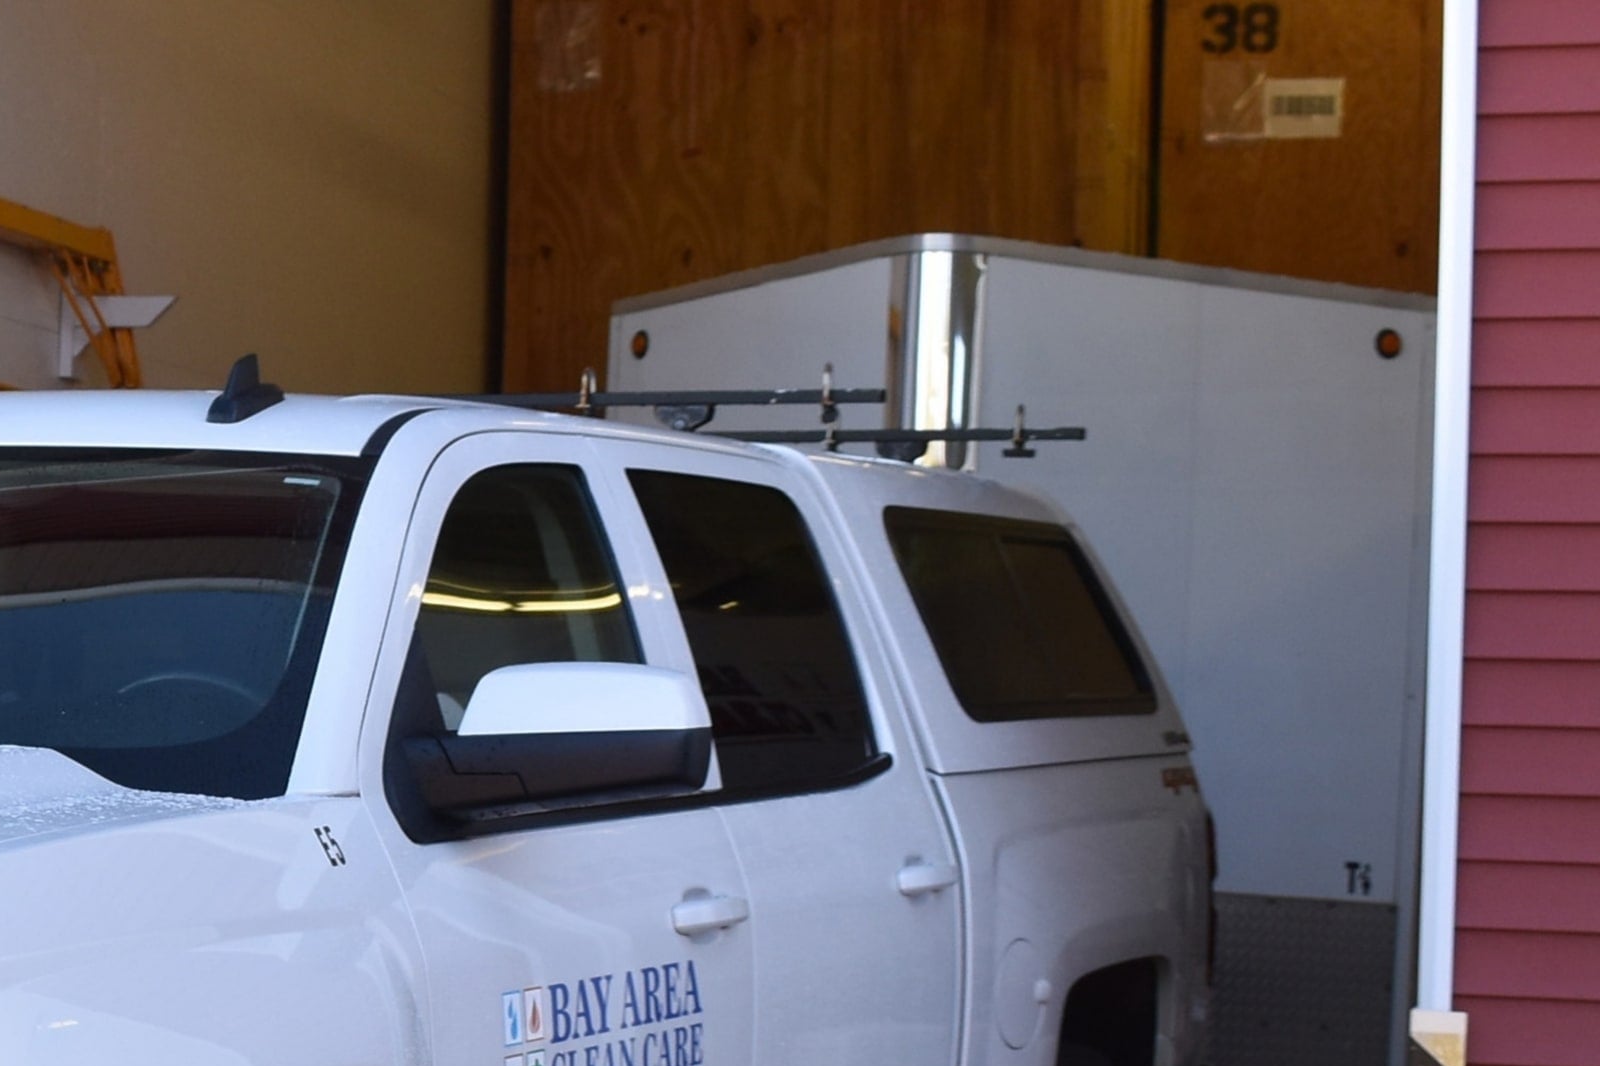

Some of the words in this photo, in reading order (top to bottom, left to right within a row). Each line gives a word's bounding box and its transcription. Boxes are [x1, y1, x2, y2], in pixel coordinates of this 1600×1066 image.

[1201, 3, 1280, 54] 38
[548, 973, 613, 1045] BAY
[621, 960, 703, 1029] AREA
